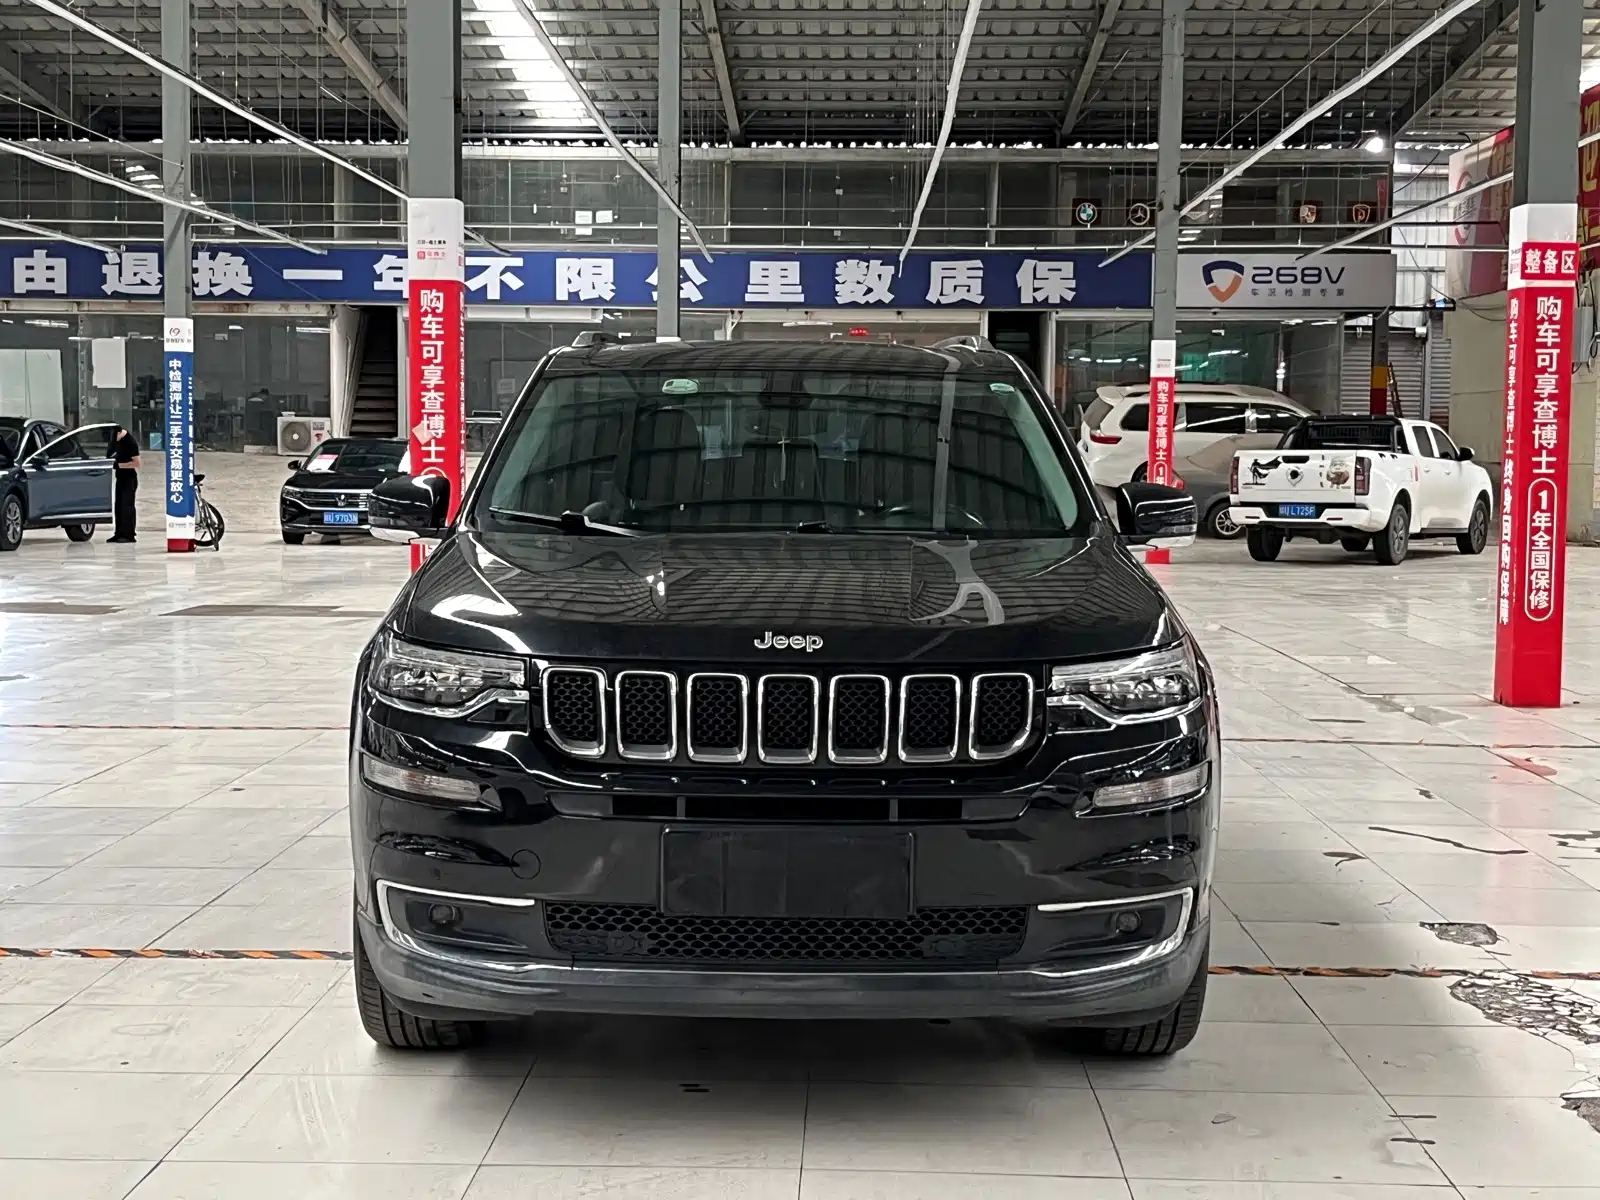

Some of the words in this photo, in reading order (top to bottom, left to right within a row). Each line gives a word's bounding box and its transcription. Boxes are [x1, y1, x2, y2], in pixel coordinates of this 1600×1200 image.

[1251, 266, 1346, 284] 268V
[1251, 288, 1345, 297] 车况检测专家
[1524, 248, 1576, 274] 整备区
[420, 289, 445, 463] 购车可享查博士
[1531, 296, 1562, 474] 购车可享查博士
[168, 358, 183, 503] 中检测评让二手车交易更放心
[1155, 381, 1169, 461] 购车可享查博士
[1529, 489, 1552, 610] 1年全国保修
[753, 631, 824, 652] Jeep
